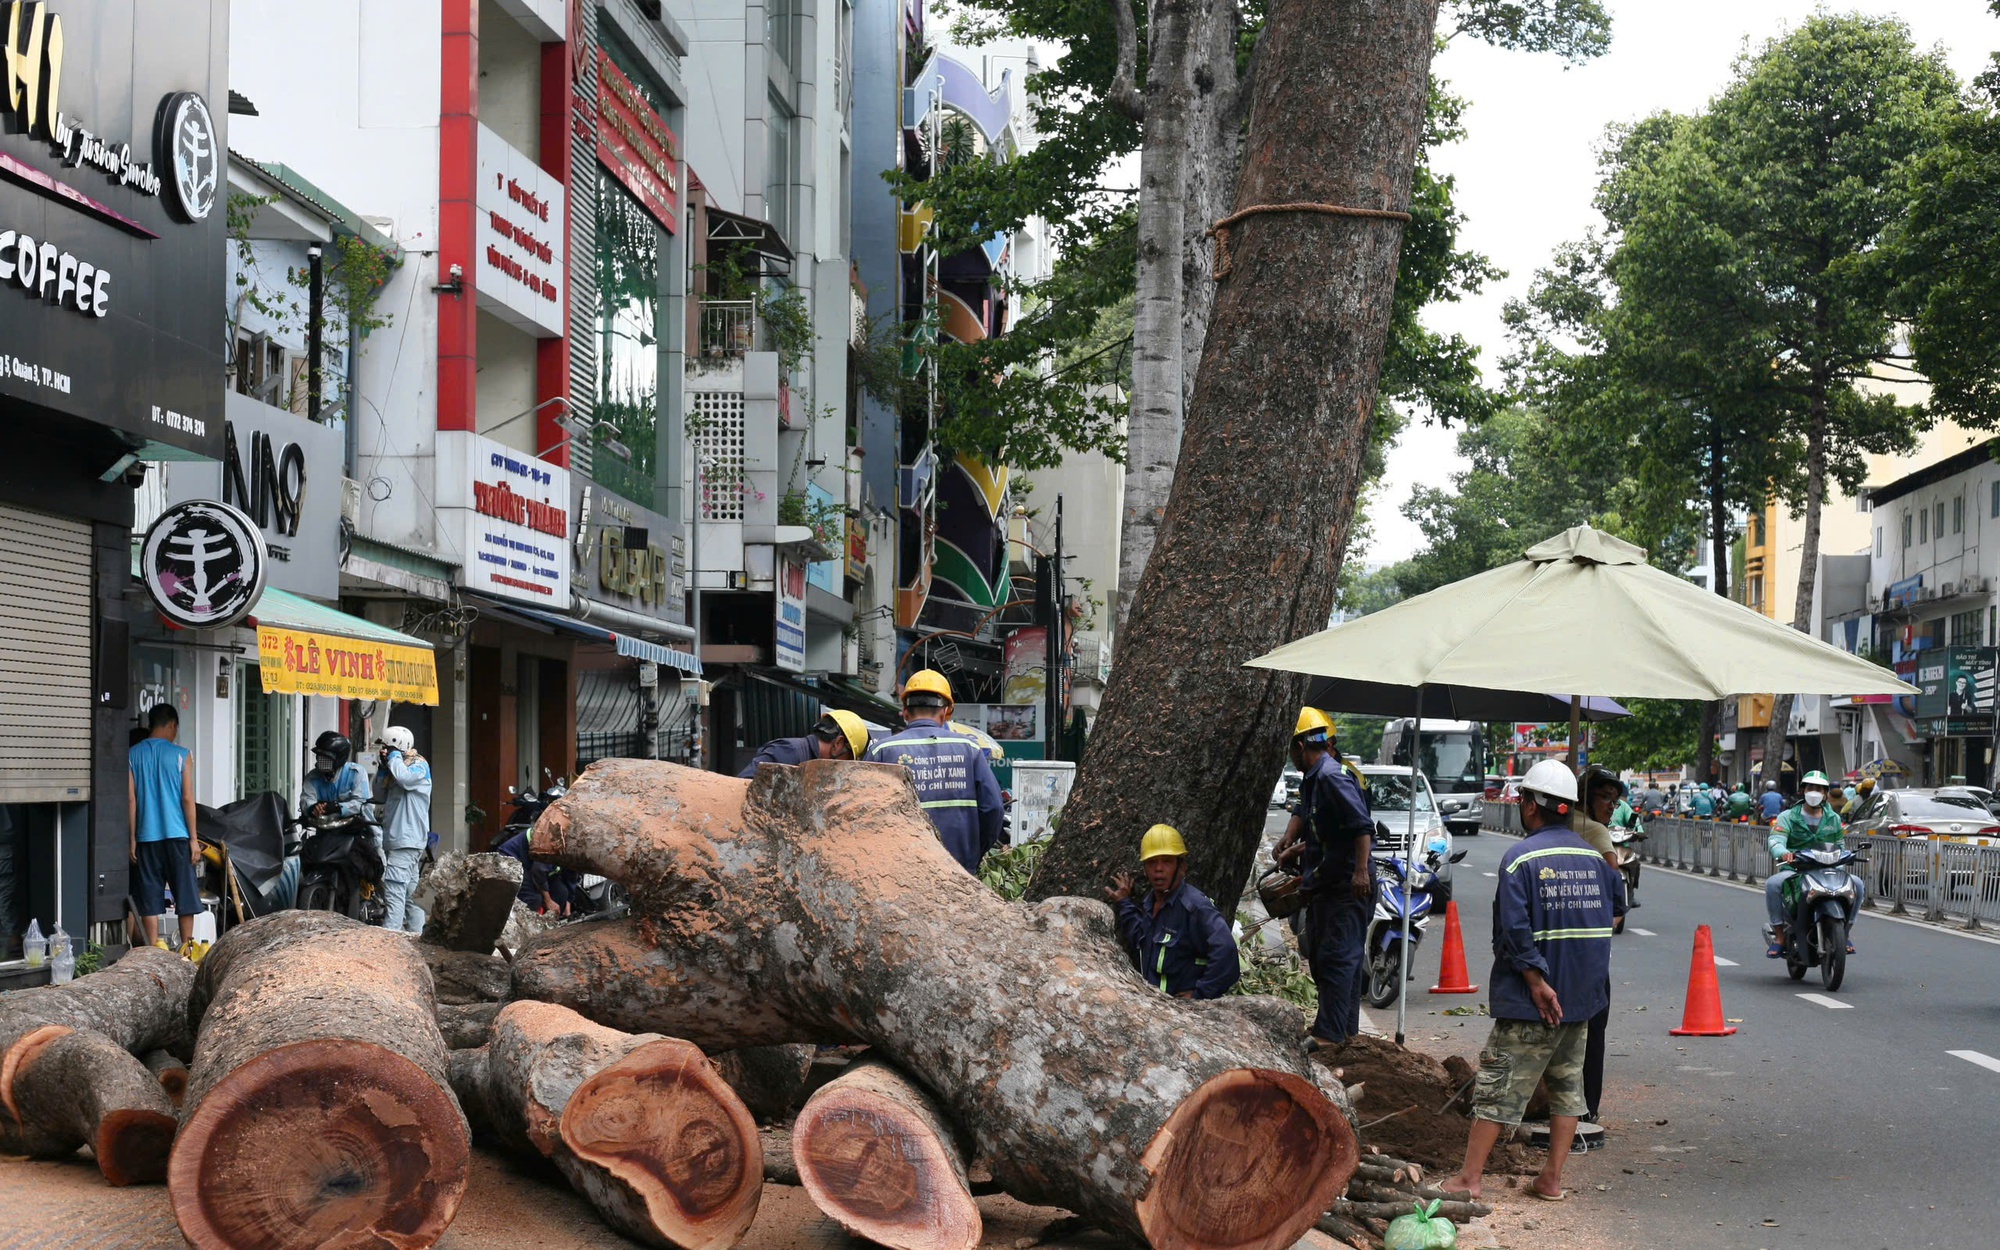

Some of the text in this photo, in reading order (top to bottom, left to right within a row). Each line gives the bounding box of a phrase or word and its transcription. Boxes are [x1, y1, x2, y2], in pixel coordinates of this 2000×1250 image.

[55, 112, 73, 159] by
[75, 128, 120, 175] Fusion
[0, 229, 111, 318] COFFEE
[4, 354, 12, 378] 5,
[12, 357, 33, 382] Quận
[33, 364, 41, 386] 3,
[261, 635, 279, 650] 372
[295, 638, 321, 674] LÊ
[325, 648, 375, 681] VINH
[914, 756, 929, 766] CÔNG
[936, 755, 952, 763] TNHH
[952, 755, 965, 763] MTV
[917, 766, 933, 780] VIÊN
[933, 765, 946, 780] CÂY
[948, 767, 967, 779] XANH
[929, 780, 943, 790] CHÍ
[945, 781, 967, 790] MINH
[1556, 868, 1568, 880] CÔNG
[1575, 870, 1587, 880] TNHH
[1539, 883, 1558, 898] CÔNG
[1573, 881, 1583, 896] CÂY
[1584, 884, 1601, 896] XANH
[1567, 899, 1581, 909] CHÍ
[1582, 900, 1602, 909] MINH
